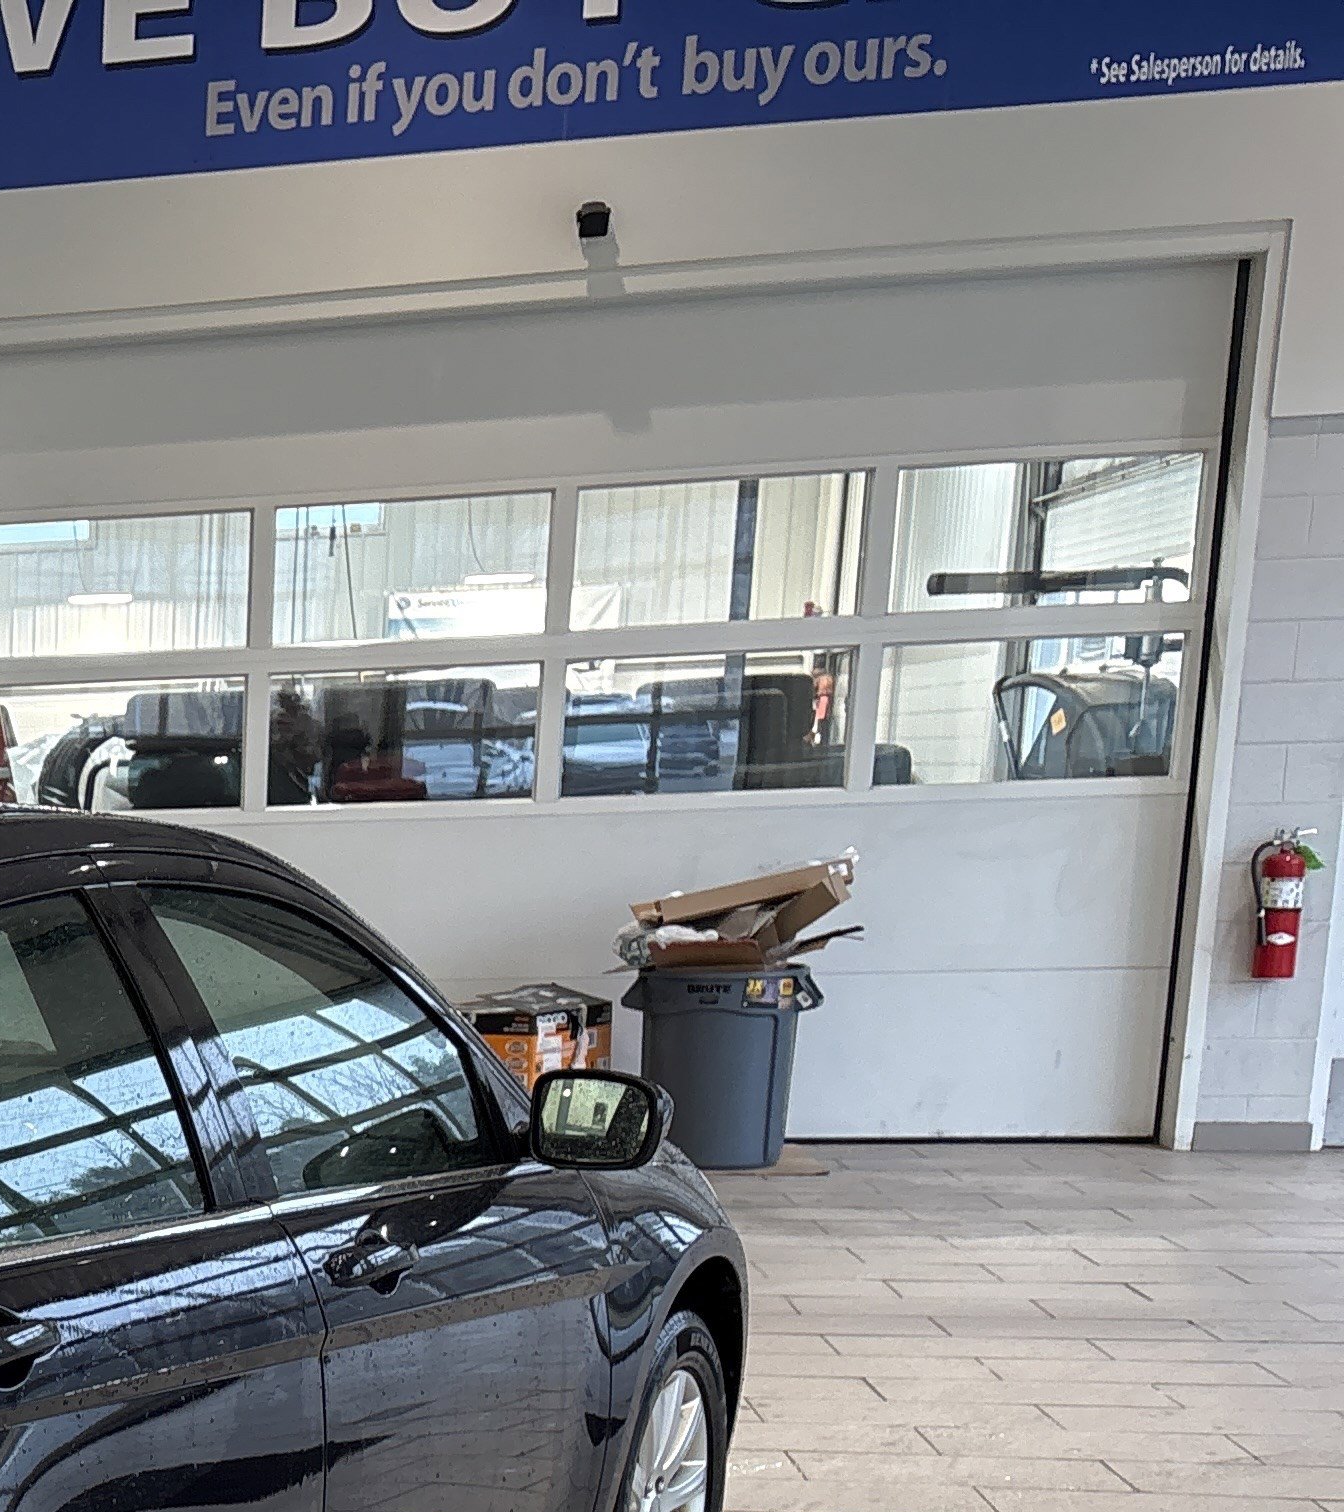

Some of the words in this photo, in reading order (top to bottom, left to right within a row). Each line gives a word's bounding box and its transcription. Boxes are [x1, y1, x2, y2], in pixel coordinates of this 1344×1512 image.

[204, 78, 333, 138] Even
[345, 60, 388, 126] if
[391, 67, 497, 137] you
[507, 40, 662, 109] don't
[680, 33, 796, 107] buy
[803, 32, 949, 86] ours.
[1129, 51, 1222, 86] Salesperson
[1223, 44, 1249, 75] for
[1249, 39, 1306, 73] details.
